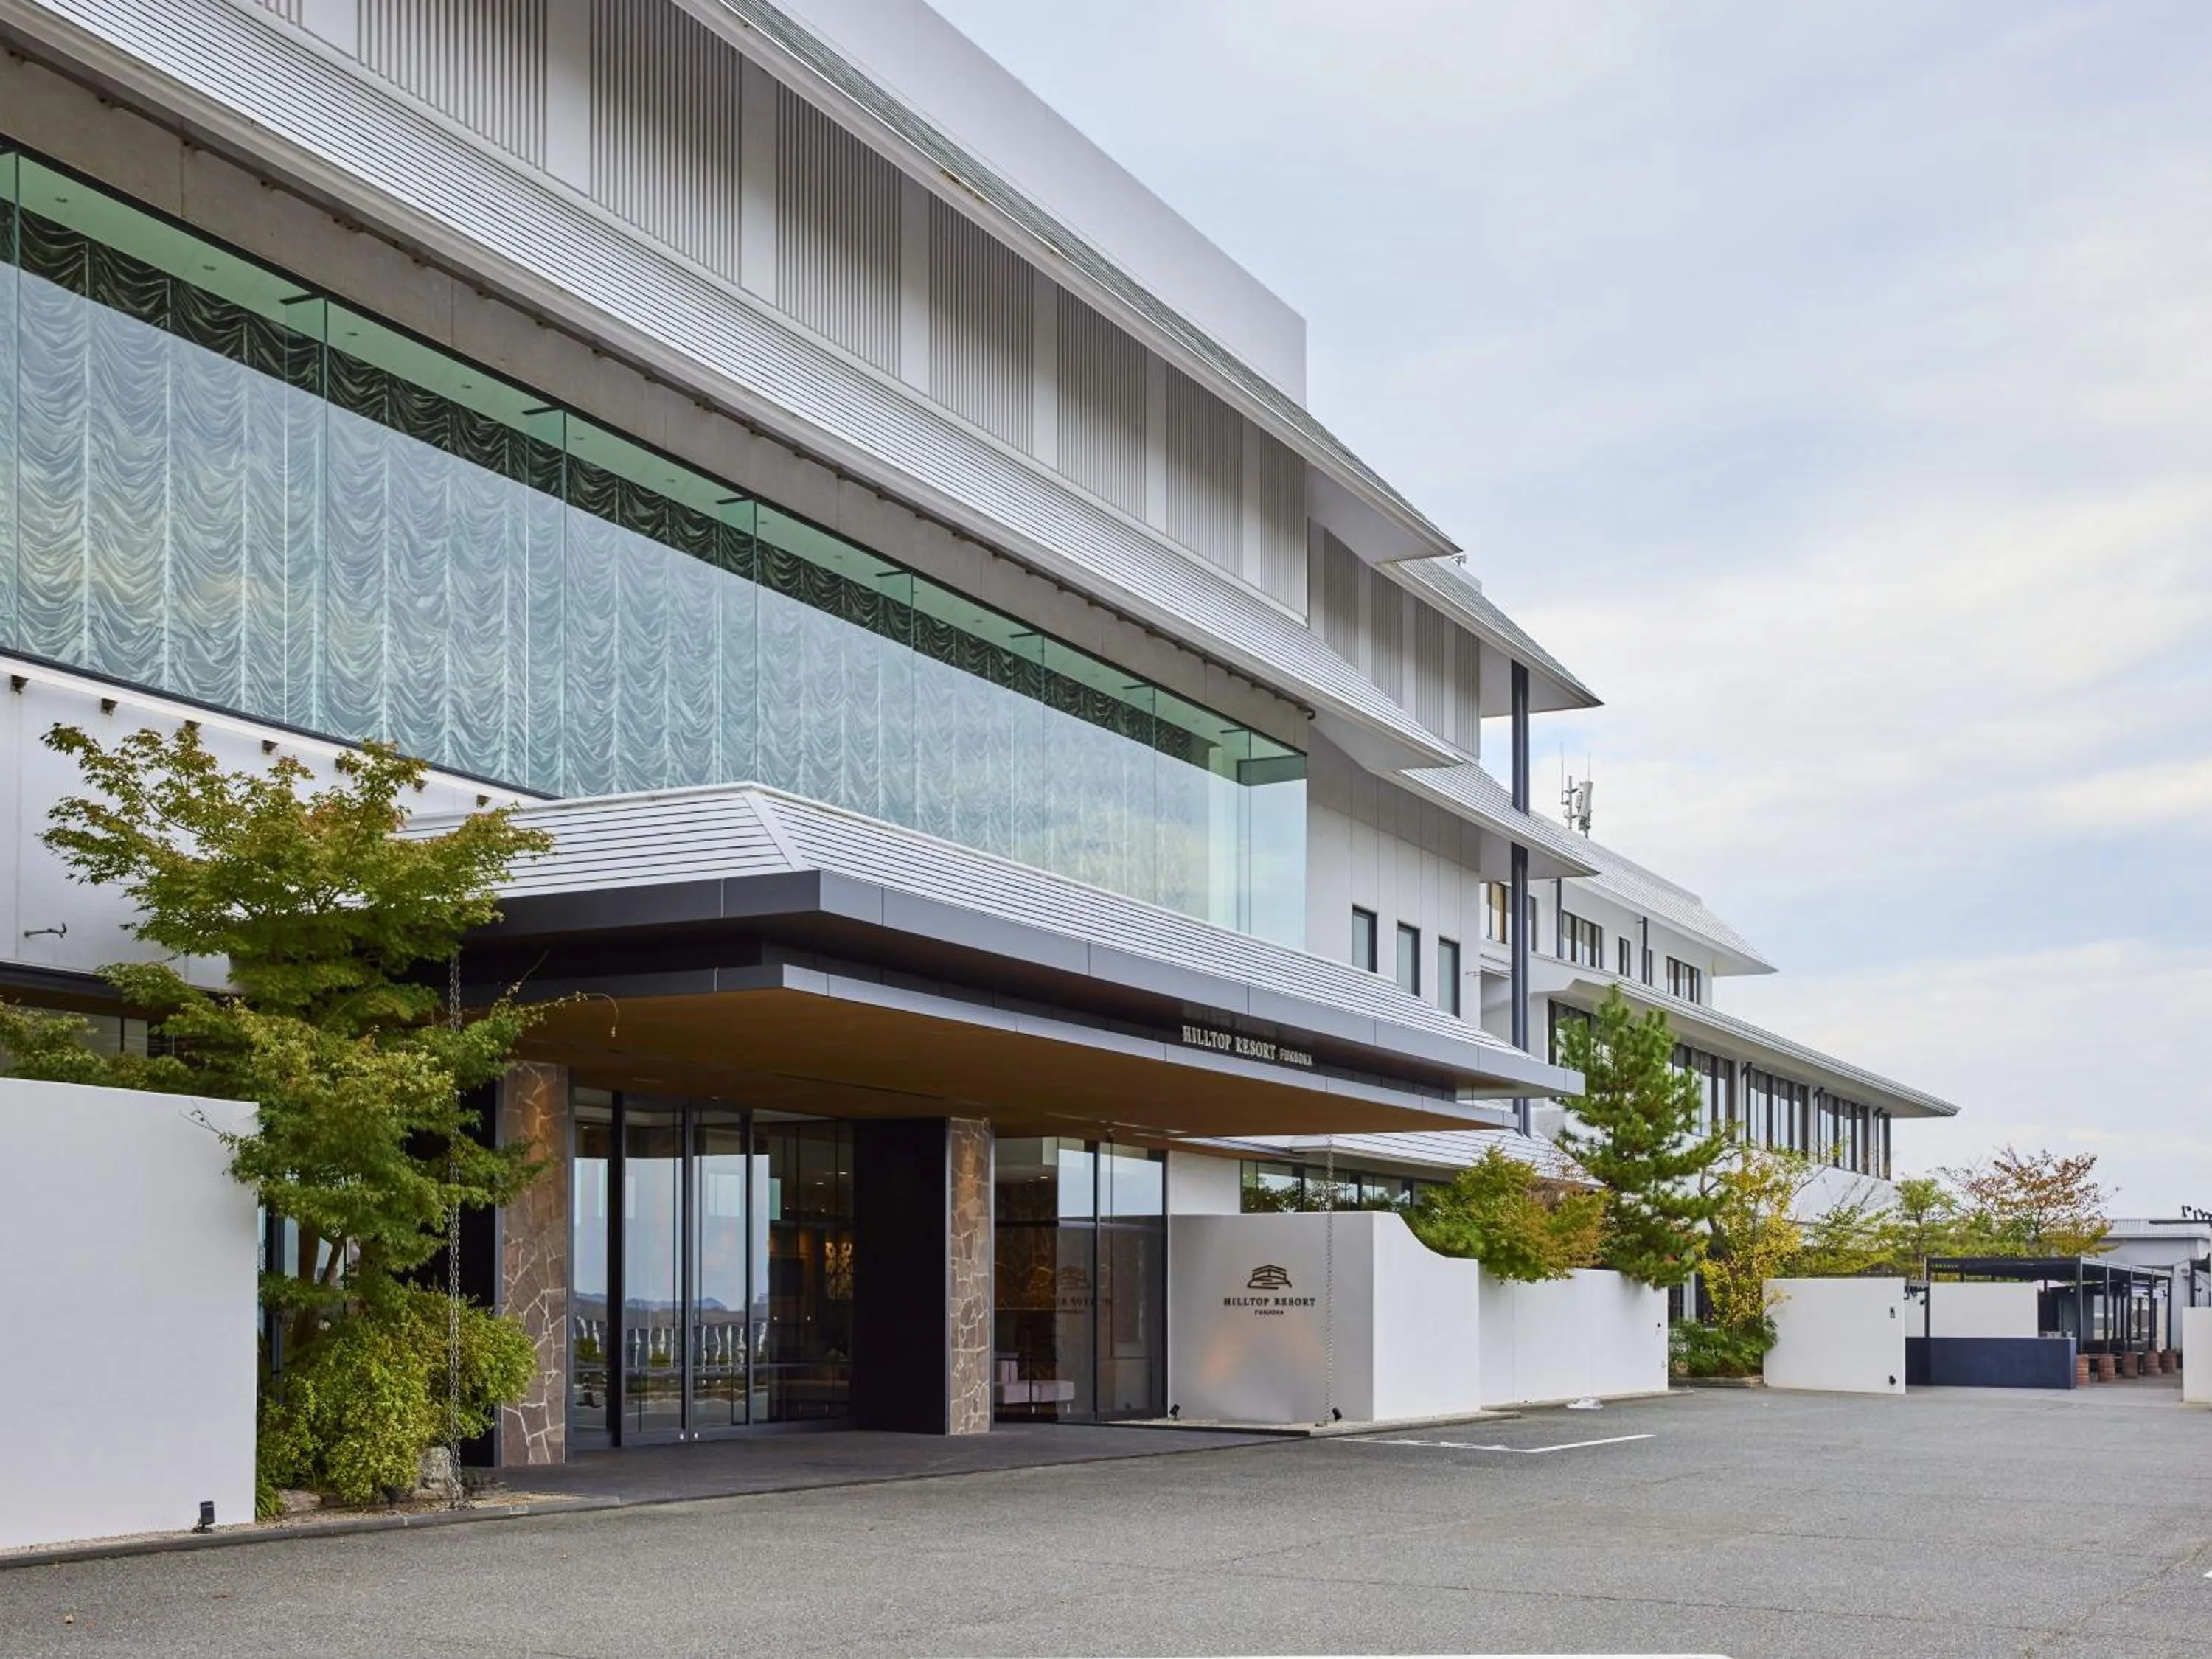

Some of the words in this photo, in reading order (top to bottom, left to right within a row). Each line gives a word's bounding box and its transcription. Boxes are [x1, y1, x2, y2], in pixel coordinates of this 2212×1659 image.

[1181, 1025, 1232, 1051] HILLTOP
[1235, 1037, 1276, 1060] RESORT
[1279, 1048, 1312, 1066] FUKUOKA
[1224, 1297, 1270, 1307] HILLTOP
[1274, 1297, 1316, 1307] RESORT
